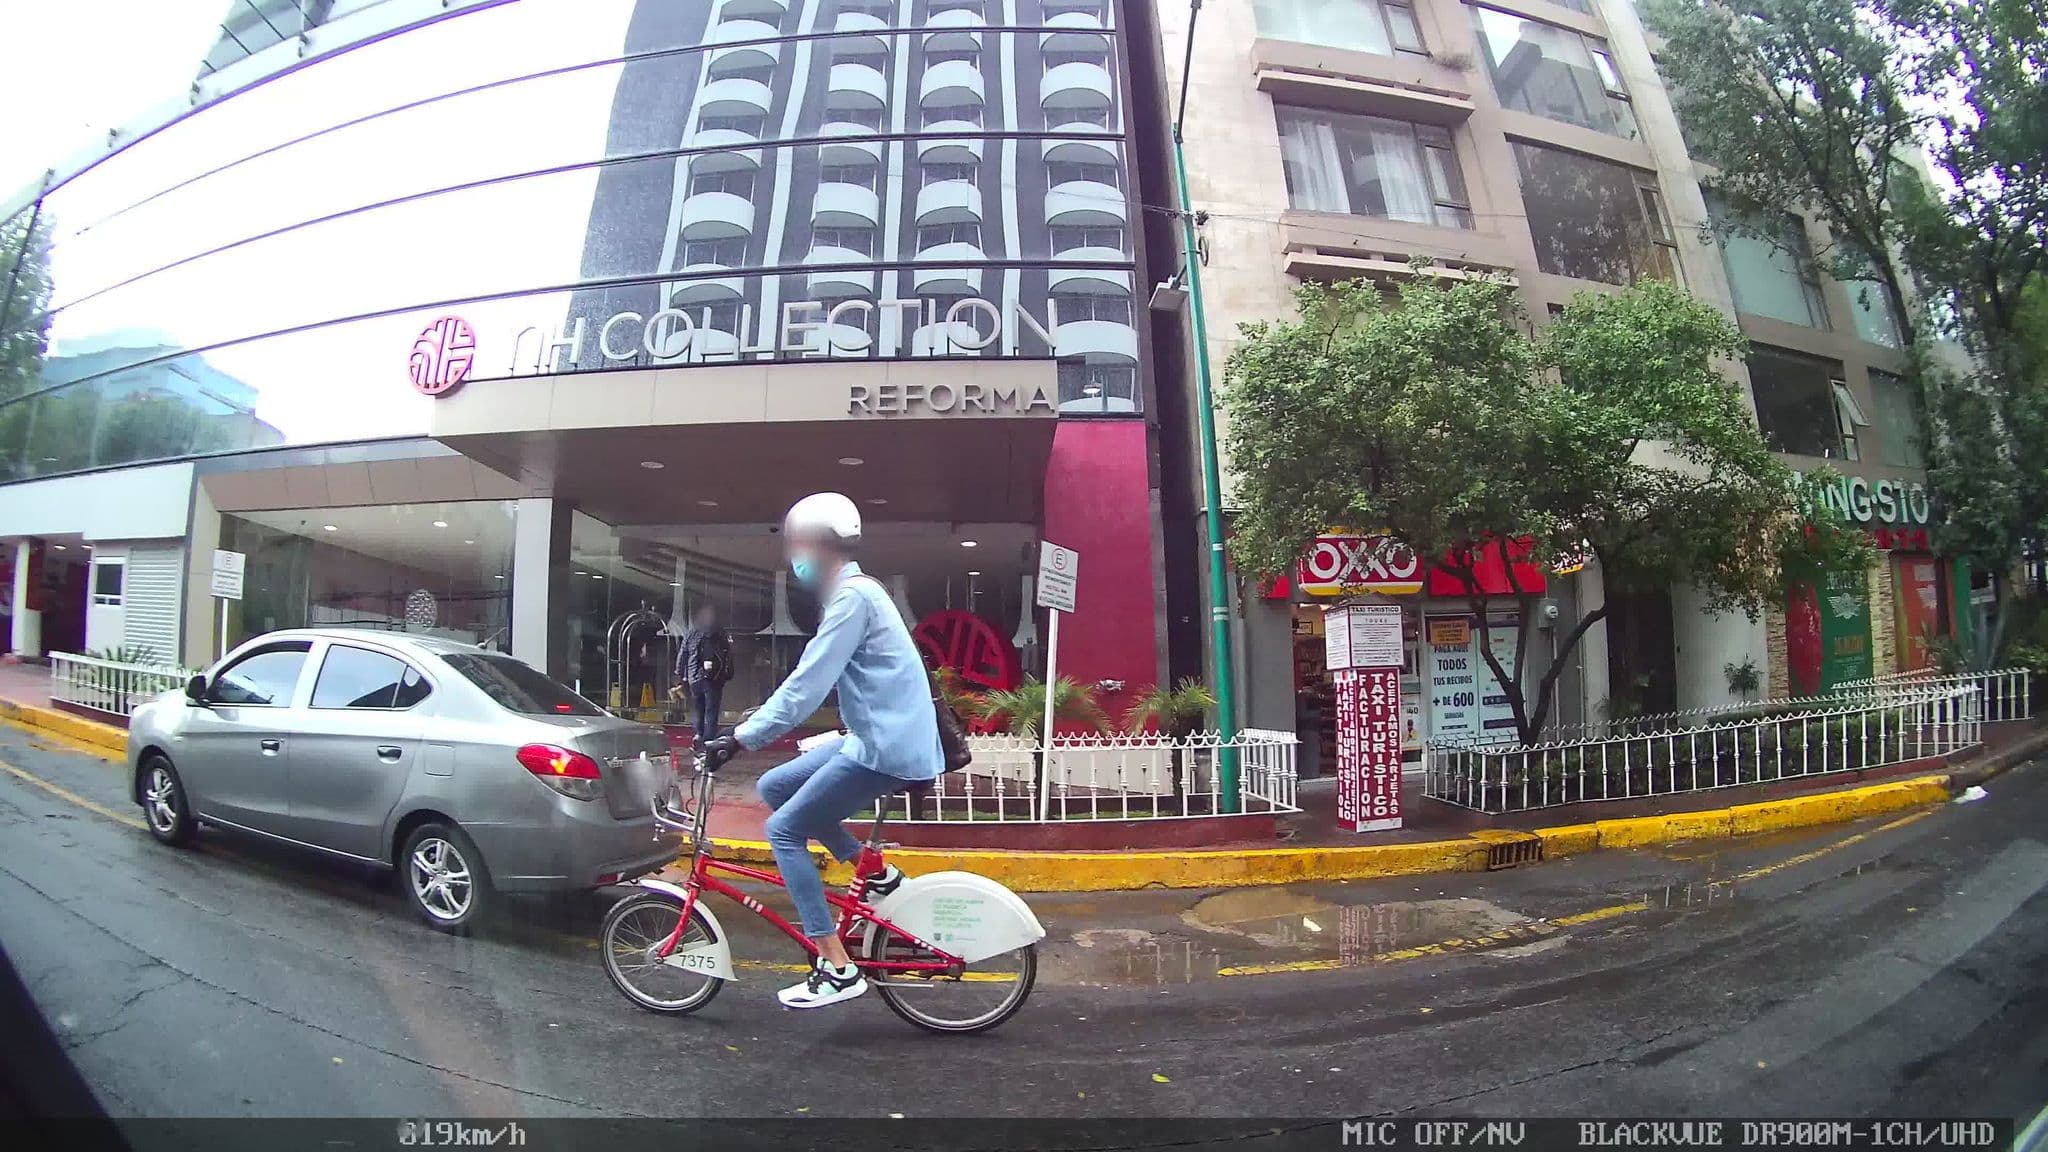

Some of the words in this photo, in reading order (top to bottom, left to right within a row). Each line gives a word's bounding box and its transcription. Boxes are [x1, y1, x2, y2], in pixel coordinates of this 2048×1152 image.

[600, 298, 1057, 361] COLLECTION
[848, 384, 1056, 415] REFORMA
[1055, 553, 1063, 566] E
[1308, 541, 1418, 579] OXXO
[1433, 676, 1446, 686] TUS
[1446, 675, 1473, 685] RECIBOS
[1437, 658, 1468, 671] TODOS
[1370, 673, 1386, 716] TAXI
[1386, 672, 1398, 747] ACEPTAMOS
[1442, 695, 1452, 706] DE
[1453, 692, 1475, 707] 600
[1358, 674, 1371, 818] FACTURACION
[1343, 727, 1351, 820] TURISTICO
[1372, 721, 1388, 816] TURISTICO
[1389, 749, 1399, 815] TARJETAS
[678, 954, 716, 969] 7375
